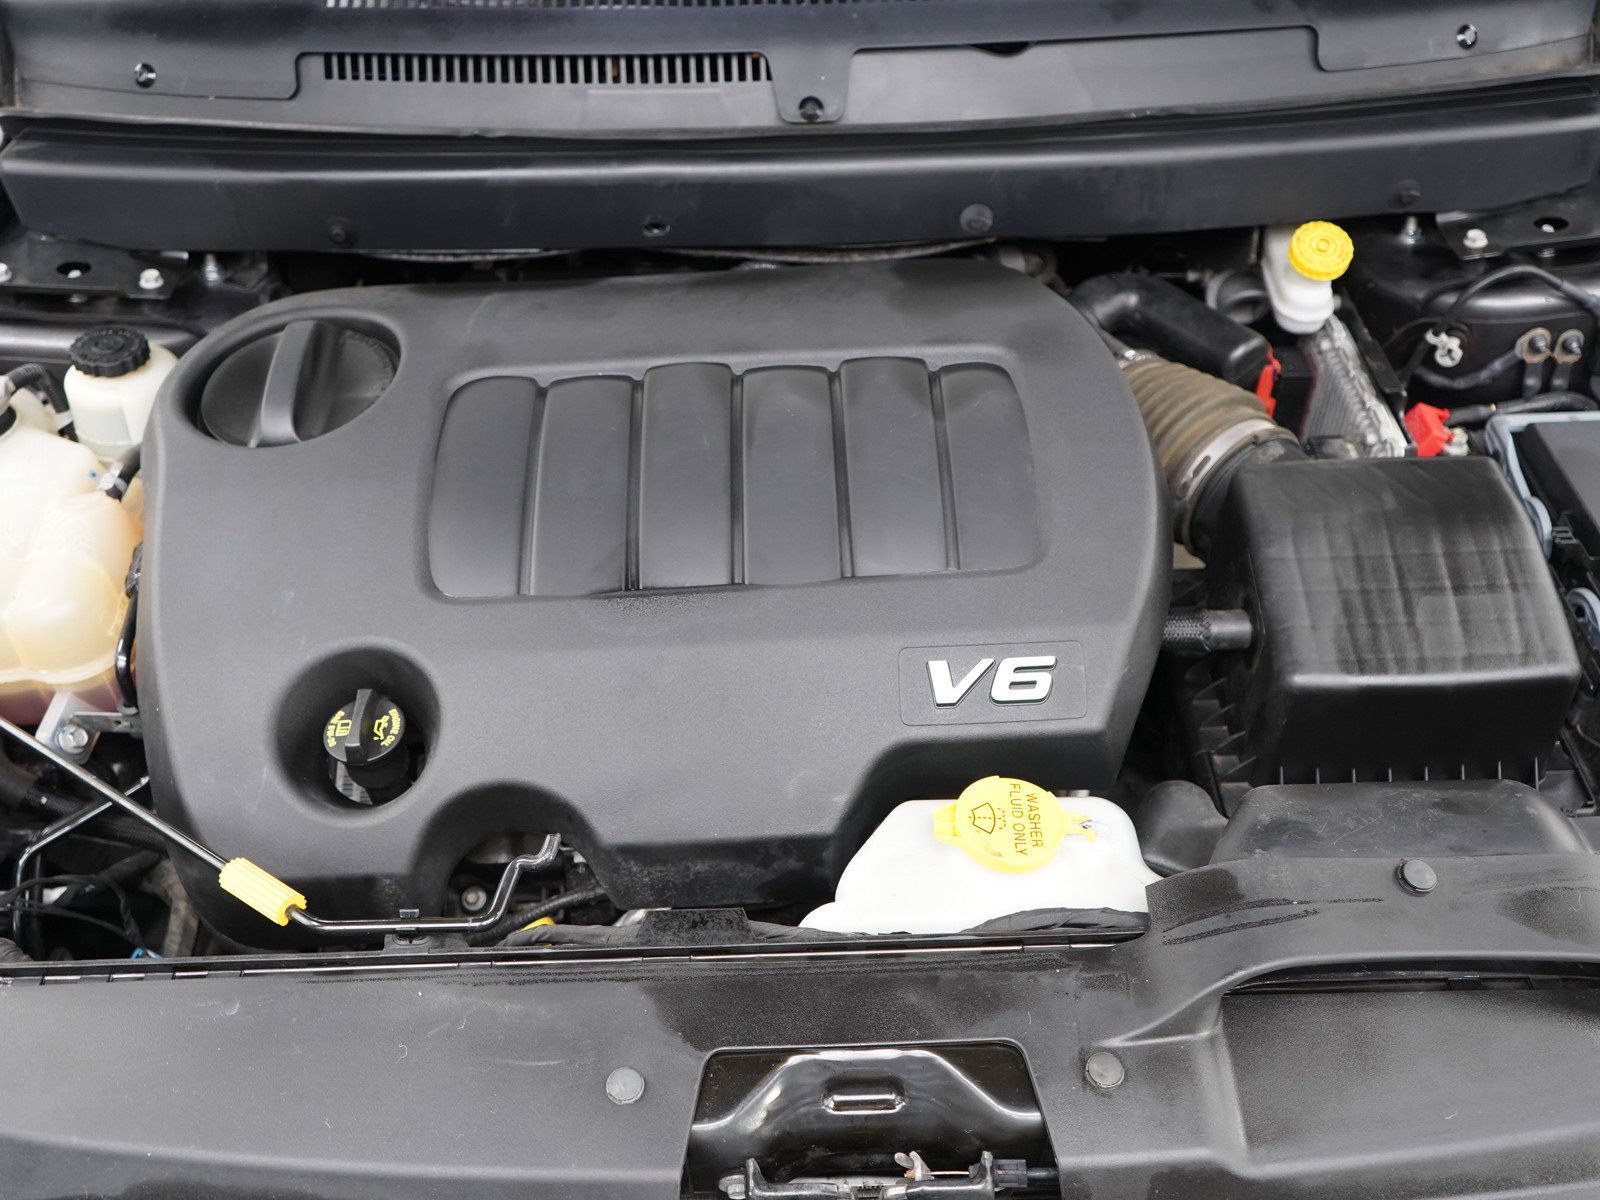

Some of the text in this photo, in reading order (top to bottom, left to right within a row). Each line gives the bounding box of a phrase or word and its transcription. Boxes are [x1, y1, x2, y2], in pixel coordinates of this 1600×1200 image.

[926, 655, 1057, 708] V6
[380, 708, 401, 747] ENGINE OIL
[1009, 783, 1028, 856] FLUID ONLY
[1026, 793, 1044, 847] WASHER
